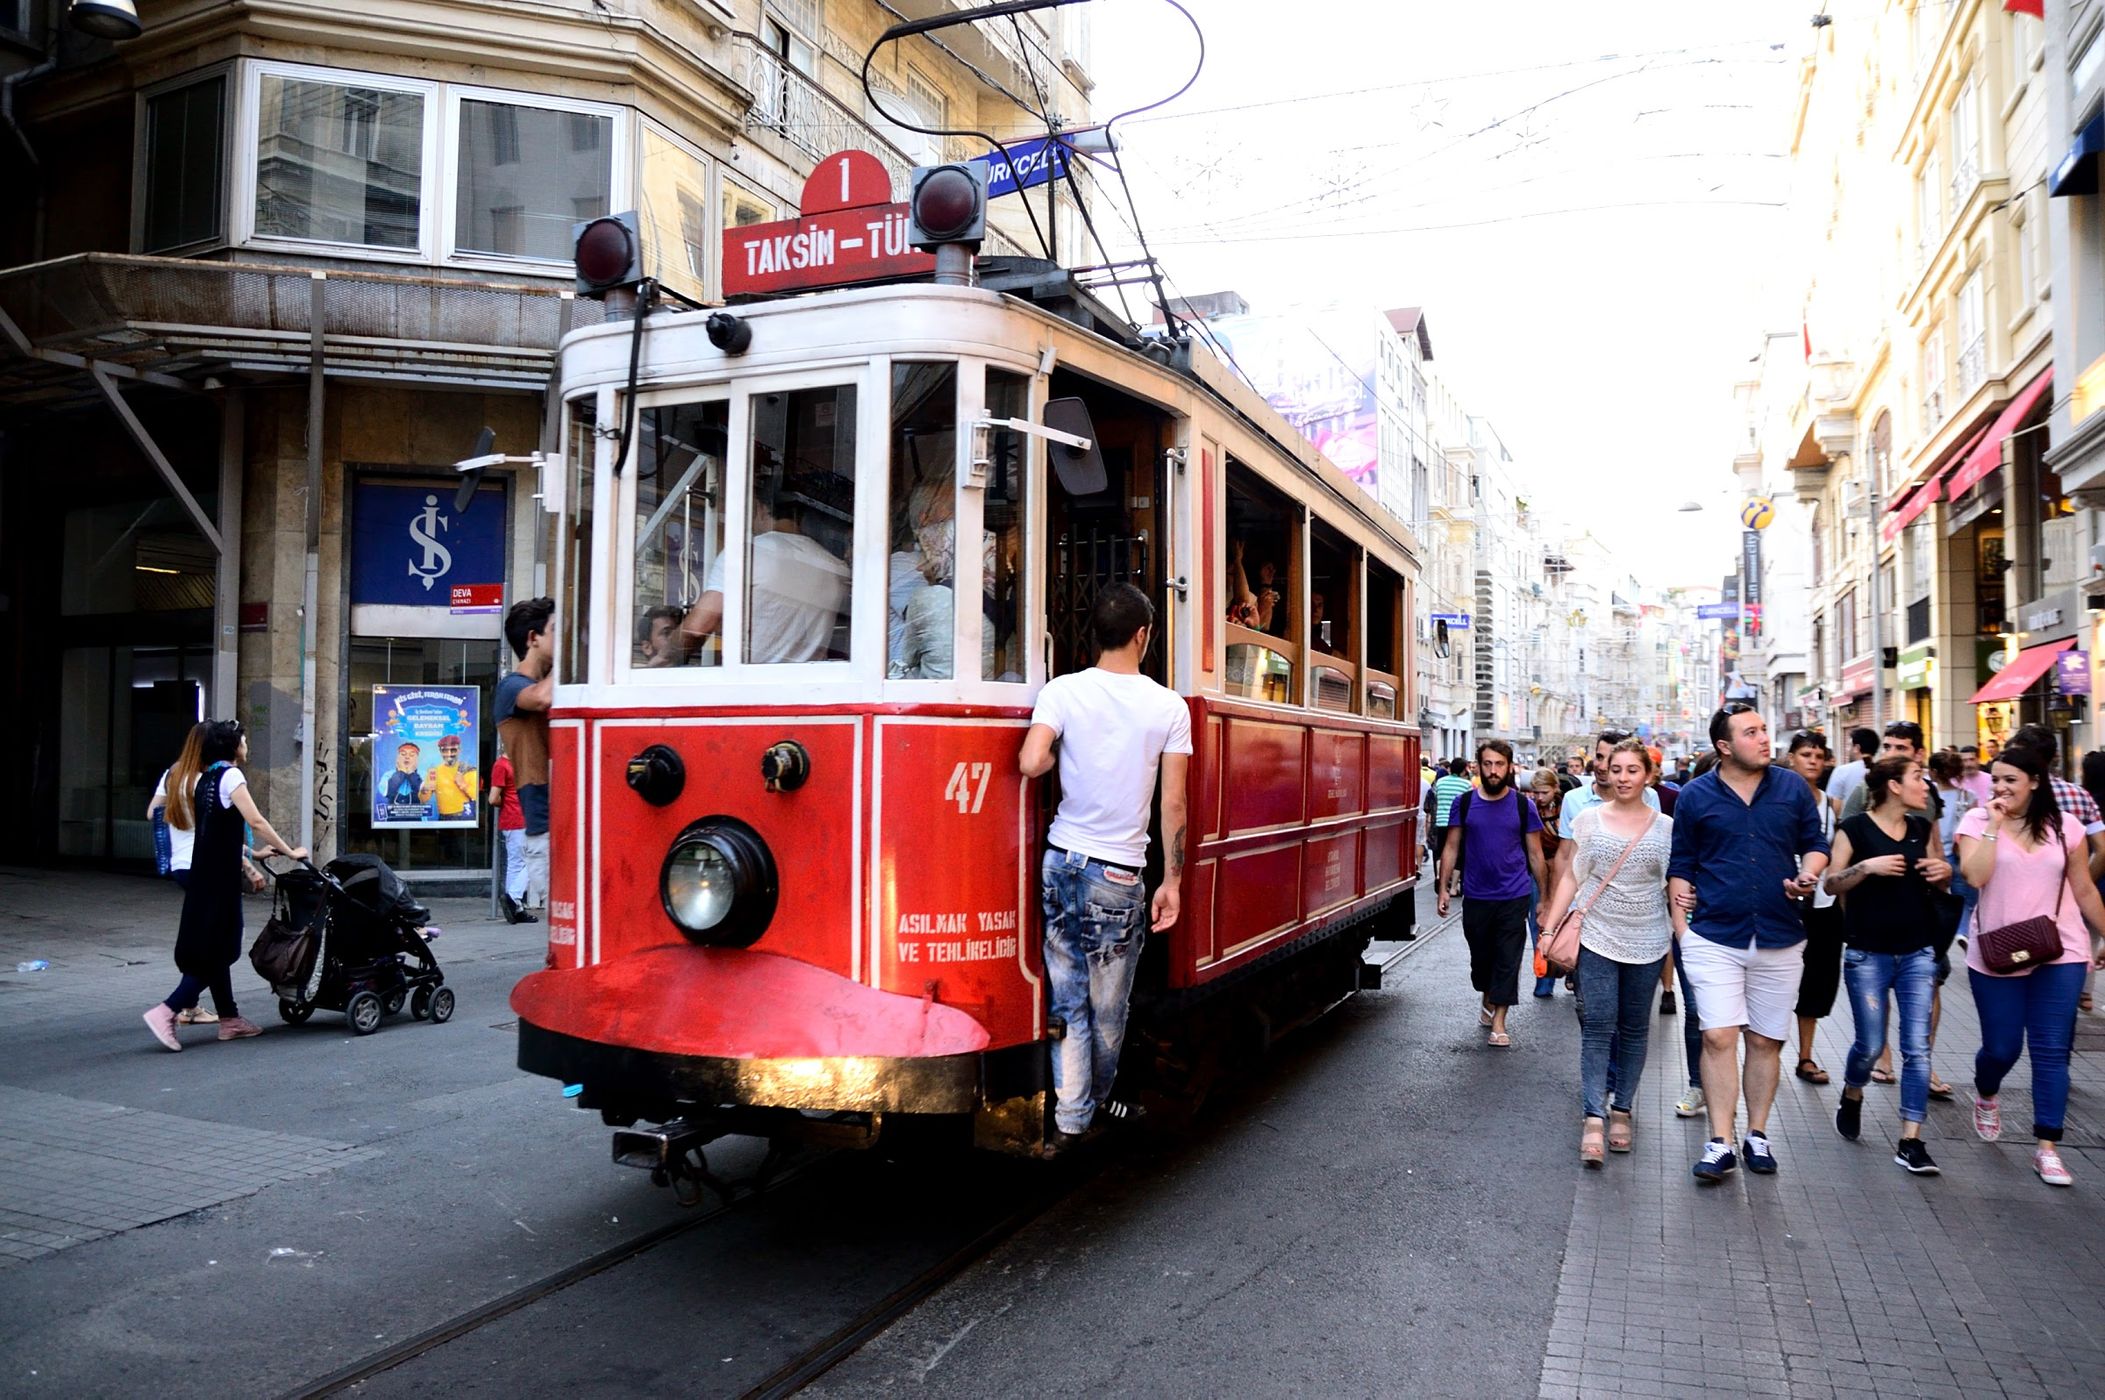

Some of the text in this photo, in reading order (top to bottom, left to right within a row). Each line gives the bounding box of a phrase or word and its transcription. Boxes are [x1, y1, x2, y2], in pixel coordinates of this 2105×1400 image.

[839, 158, 850, 202] 1
[452, 588, 472, 598] DEVA
[945, 762, 992, 814] 47
[898, 910, 1016, 935] ASILMAK YASAK
[898, 942, 920, 962] VE
